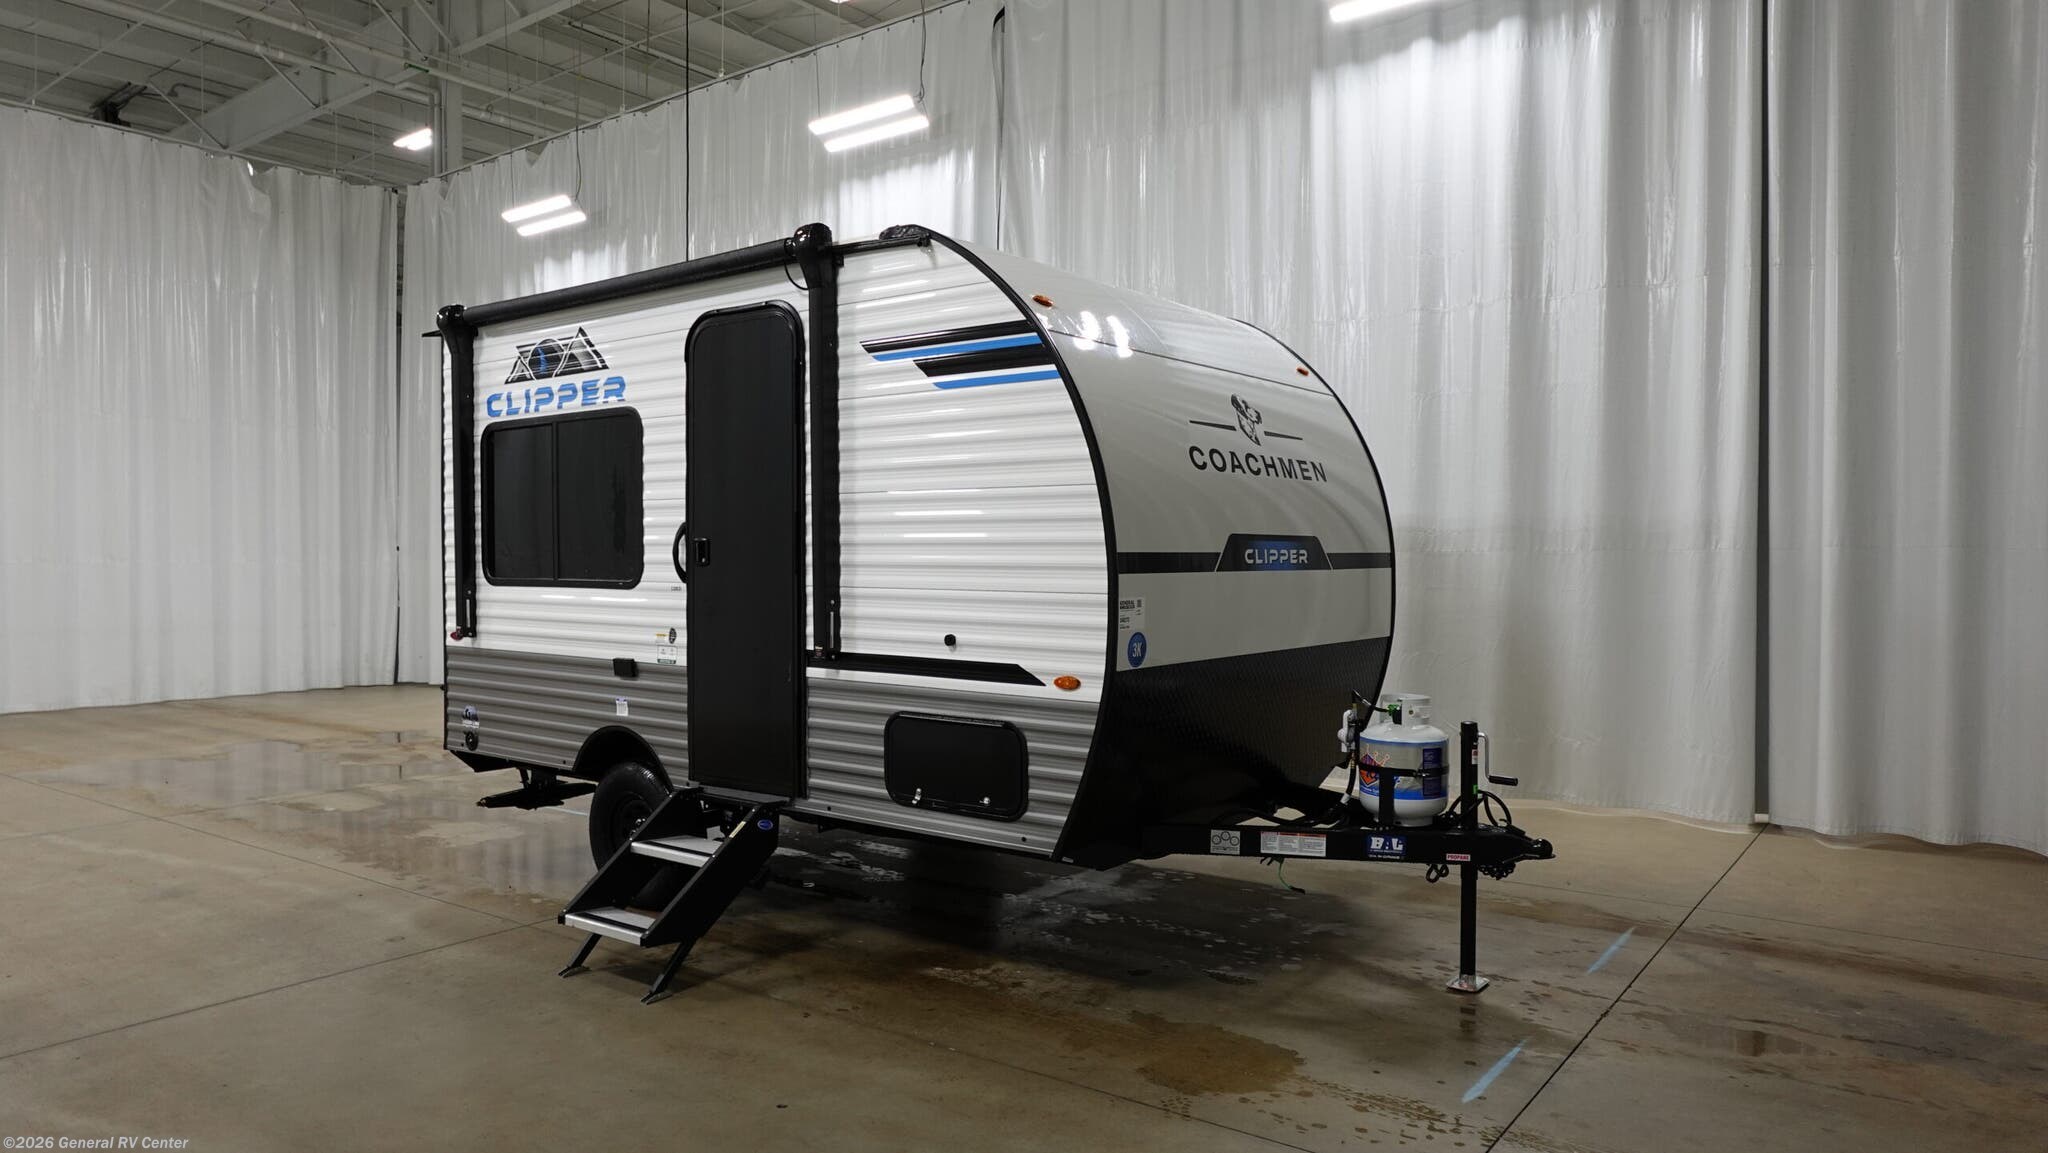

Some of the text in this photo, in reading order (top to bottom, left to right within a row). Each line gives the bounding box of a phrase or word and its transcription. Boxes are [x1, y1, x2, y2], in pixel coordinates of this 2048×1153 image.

[486, 376, 626, 418] CLIPPER
[1188, 445, 1328, 483] COACHMEN
[1244, 548, 1308, 565] CLIPPER
[1132, 642, 1143, 658] 3K
